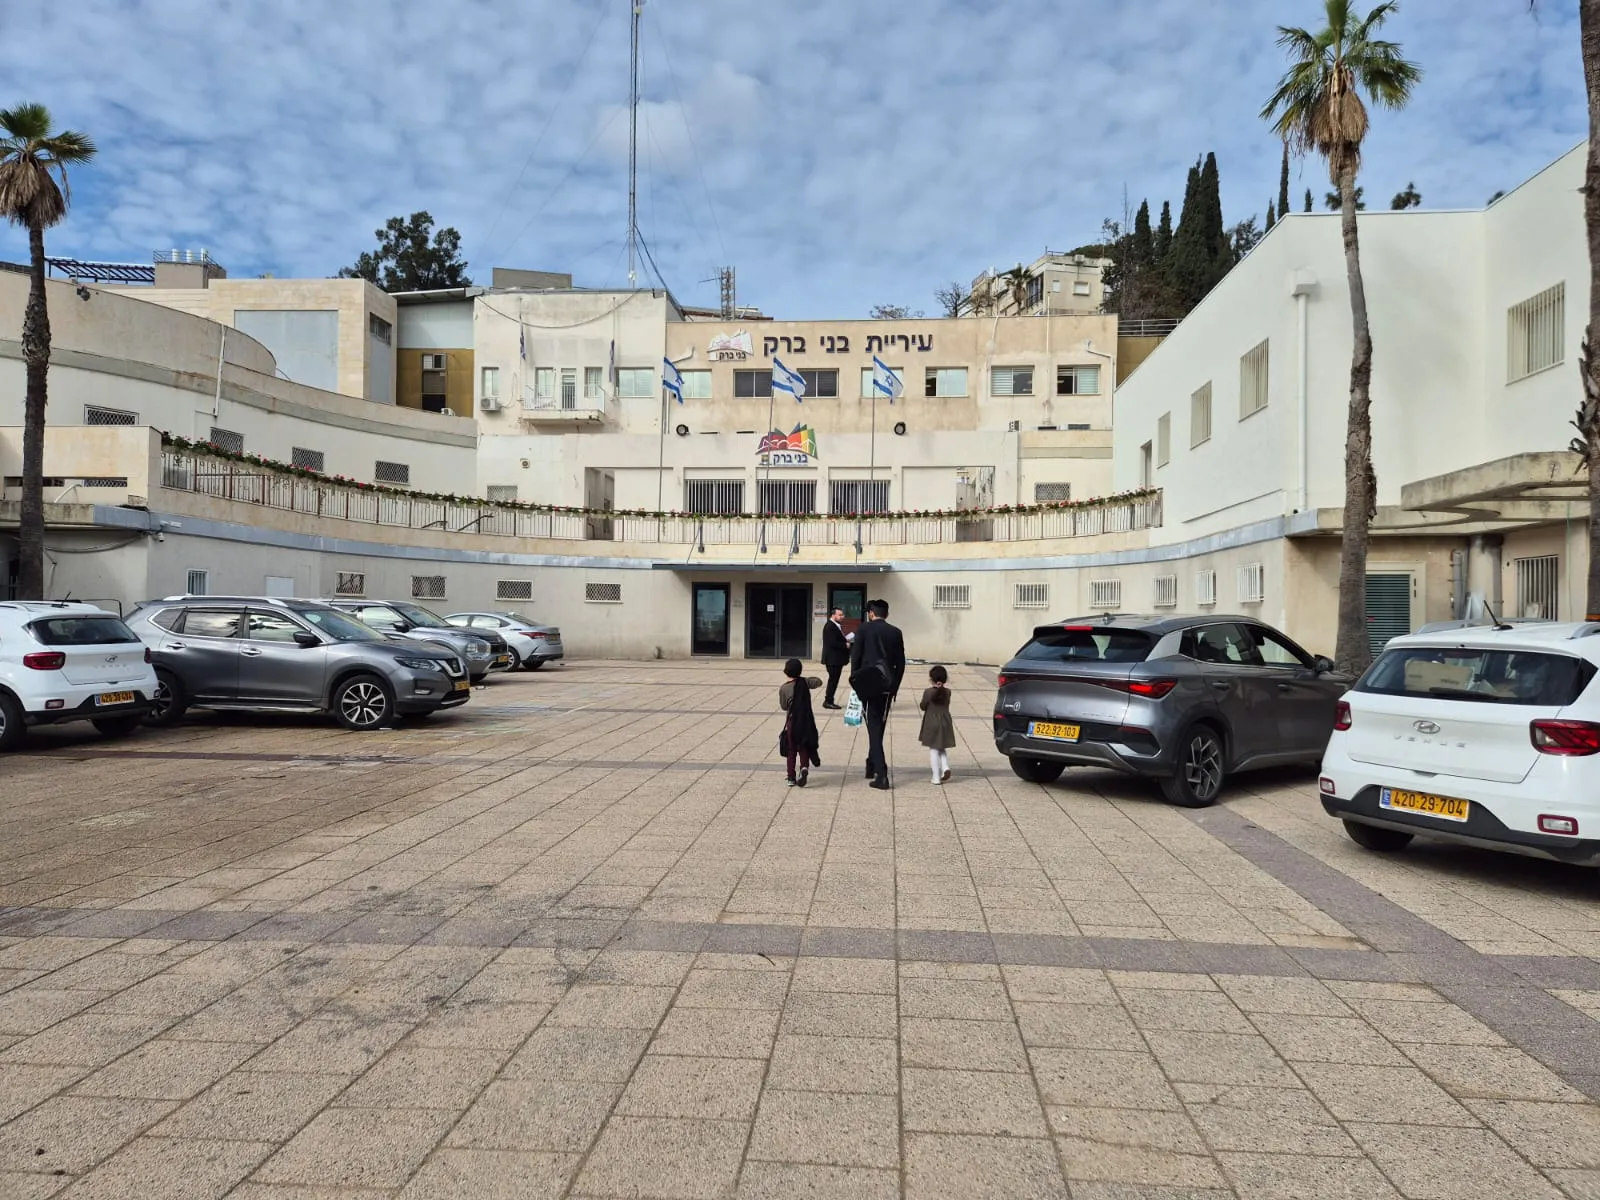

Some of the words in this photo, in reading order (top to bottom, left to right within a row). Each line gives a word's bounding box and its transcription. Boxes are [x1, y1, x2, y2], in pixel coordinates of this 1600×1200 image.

[763, 336, 806, 357] ברק
[820, 335, 850, 353] בני
[865, 334, 933, 353] עיריית
[719, 351, 734, 361] ברק
[735, 351, 747, 360] בני
[773, 454, 792, 466] ברק
[794, 454, 808, 464] בני
